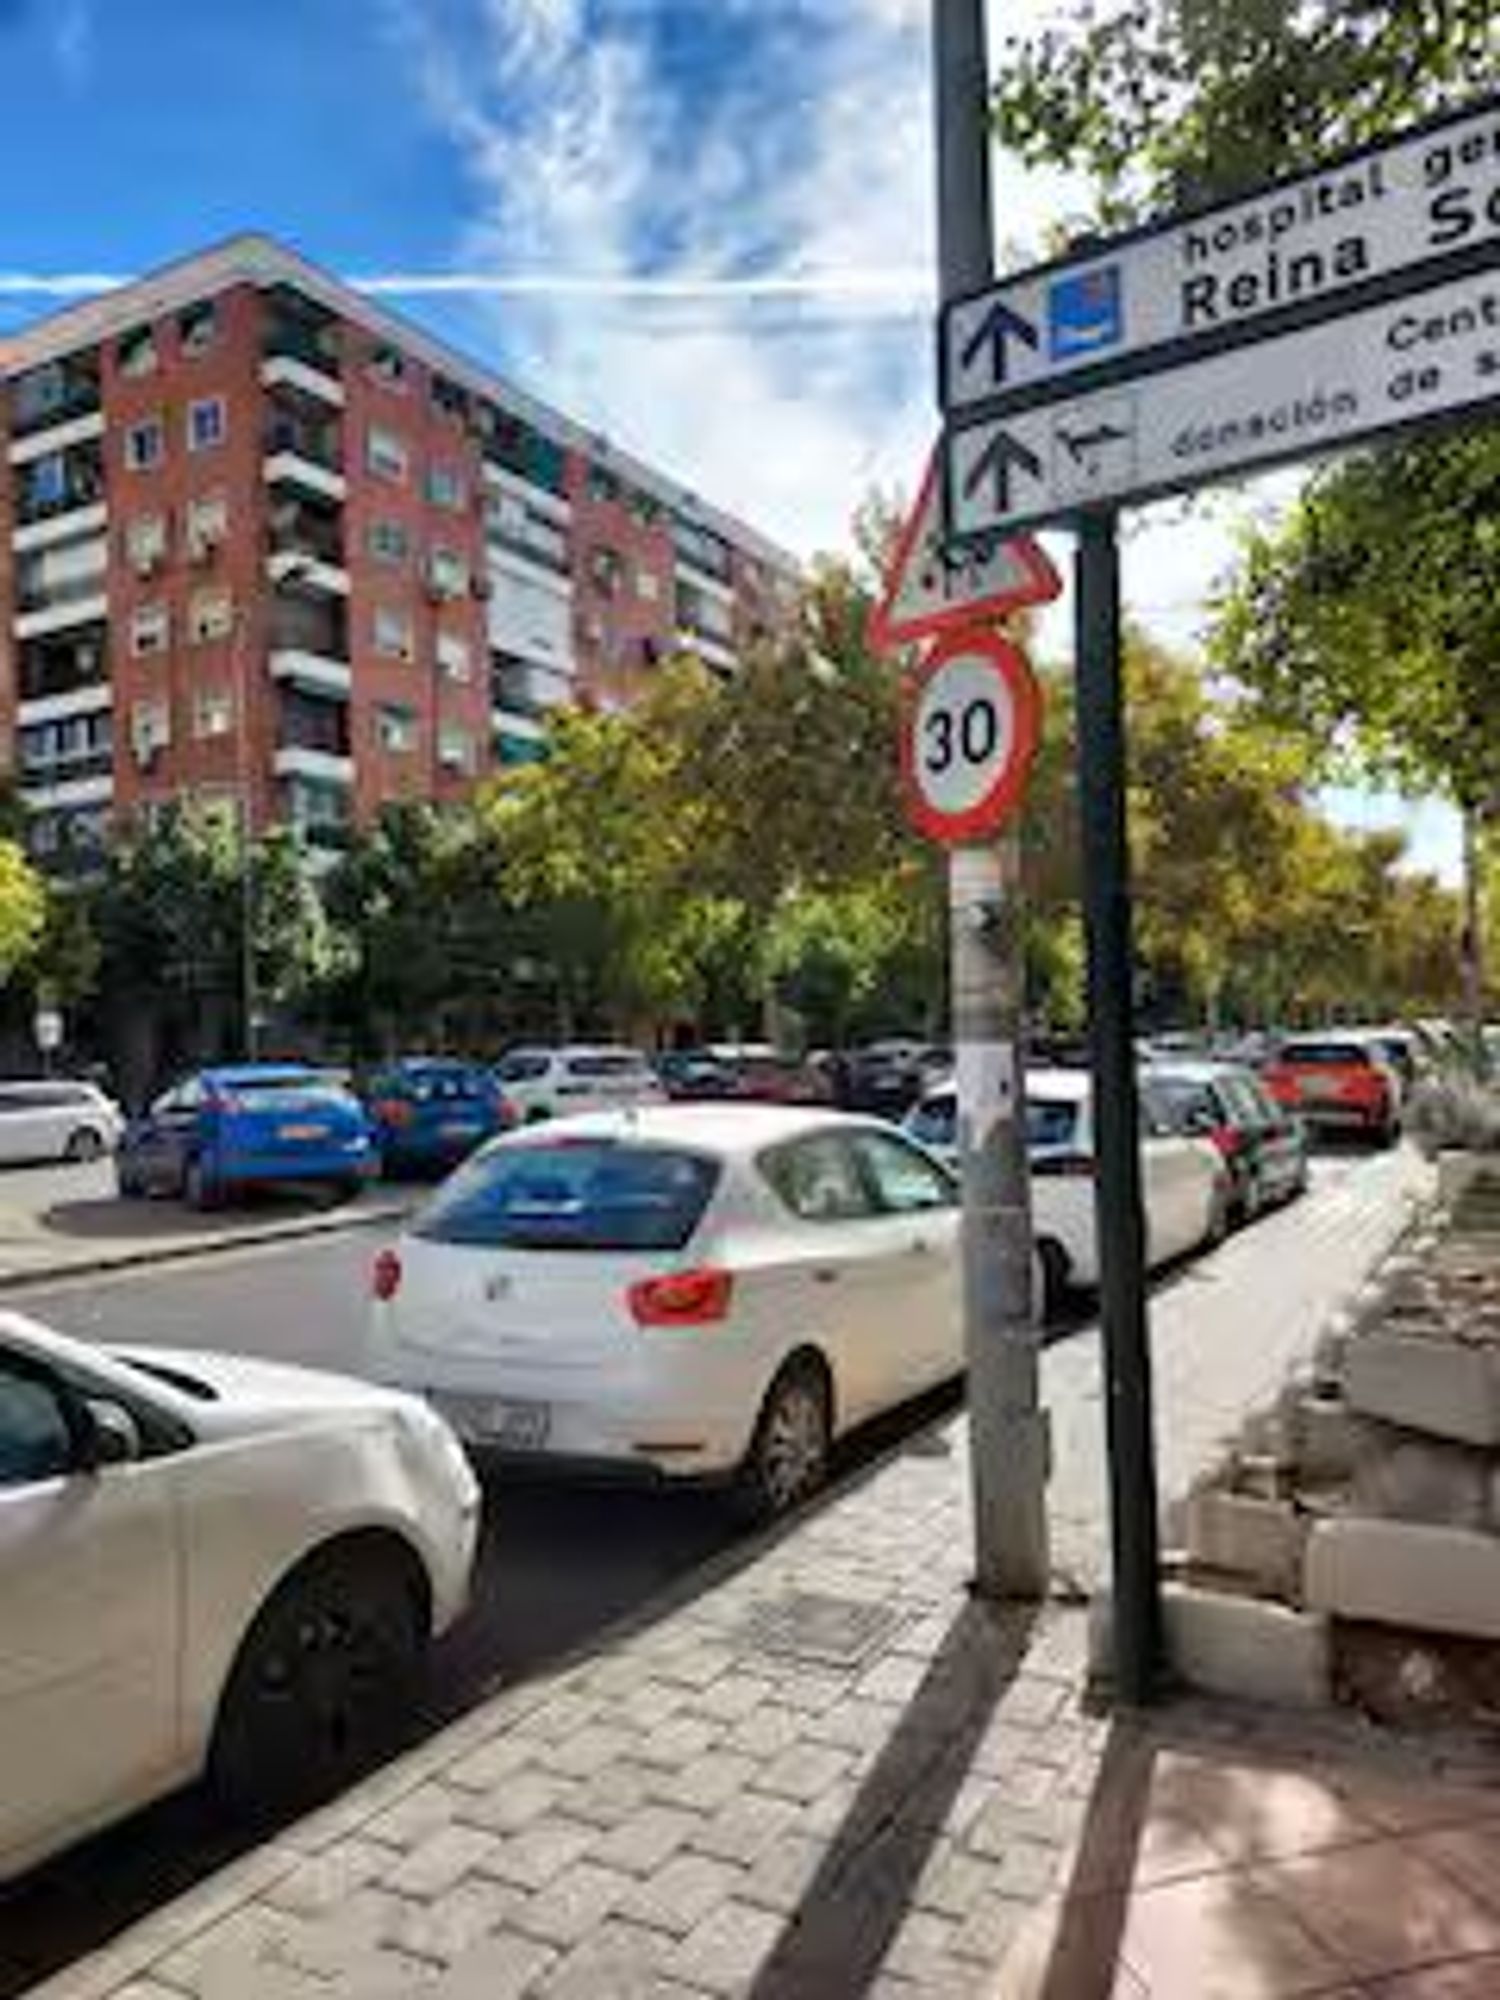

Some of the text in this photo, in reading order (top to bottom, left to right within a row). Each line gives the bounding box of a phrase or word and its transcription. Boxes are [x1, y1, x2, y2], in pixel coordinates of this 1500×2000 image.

[1184, 162, 1382, 267] hospital
[1182, 237, 1369, 326] Reina
[1387, 369, 1440, 402] de
[924, 698, 997, 772] 30
